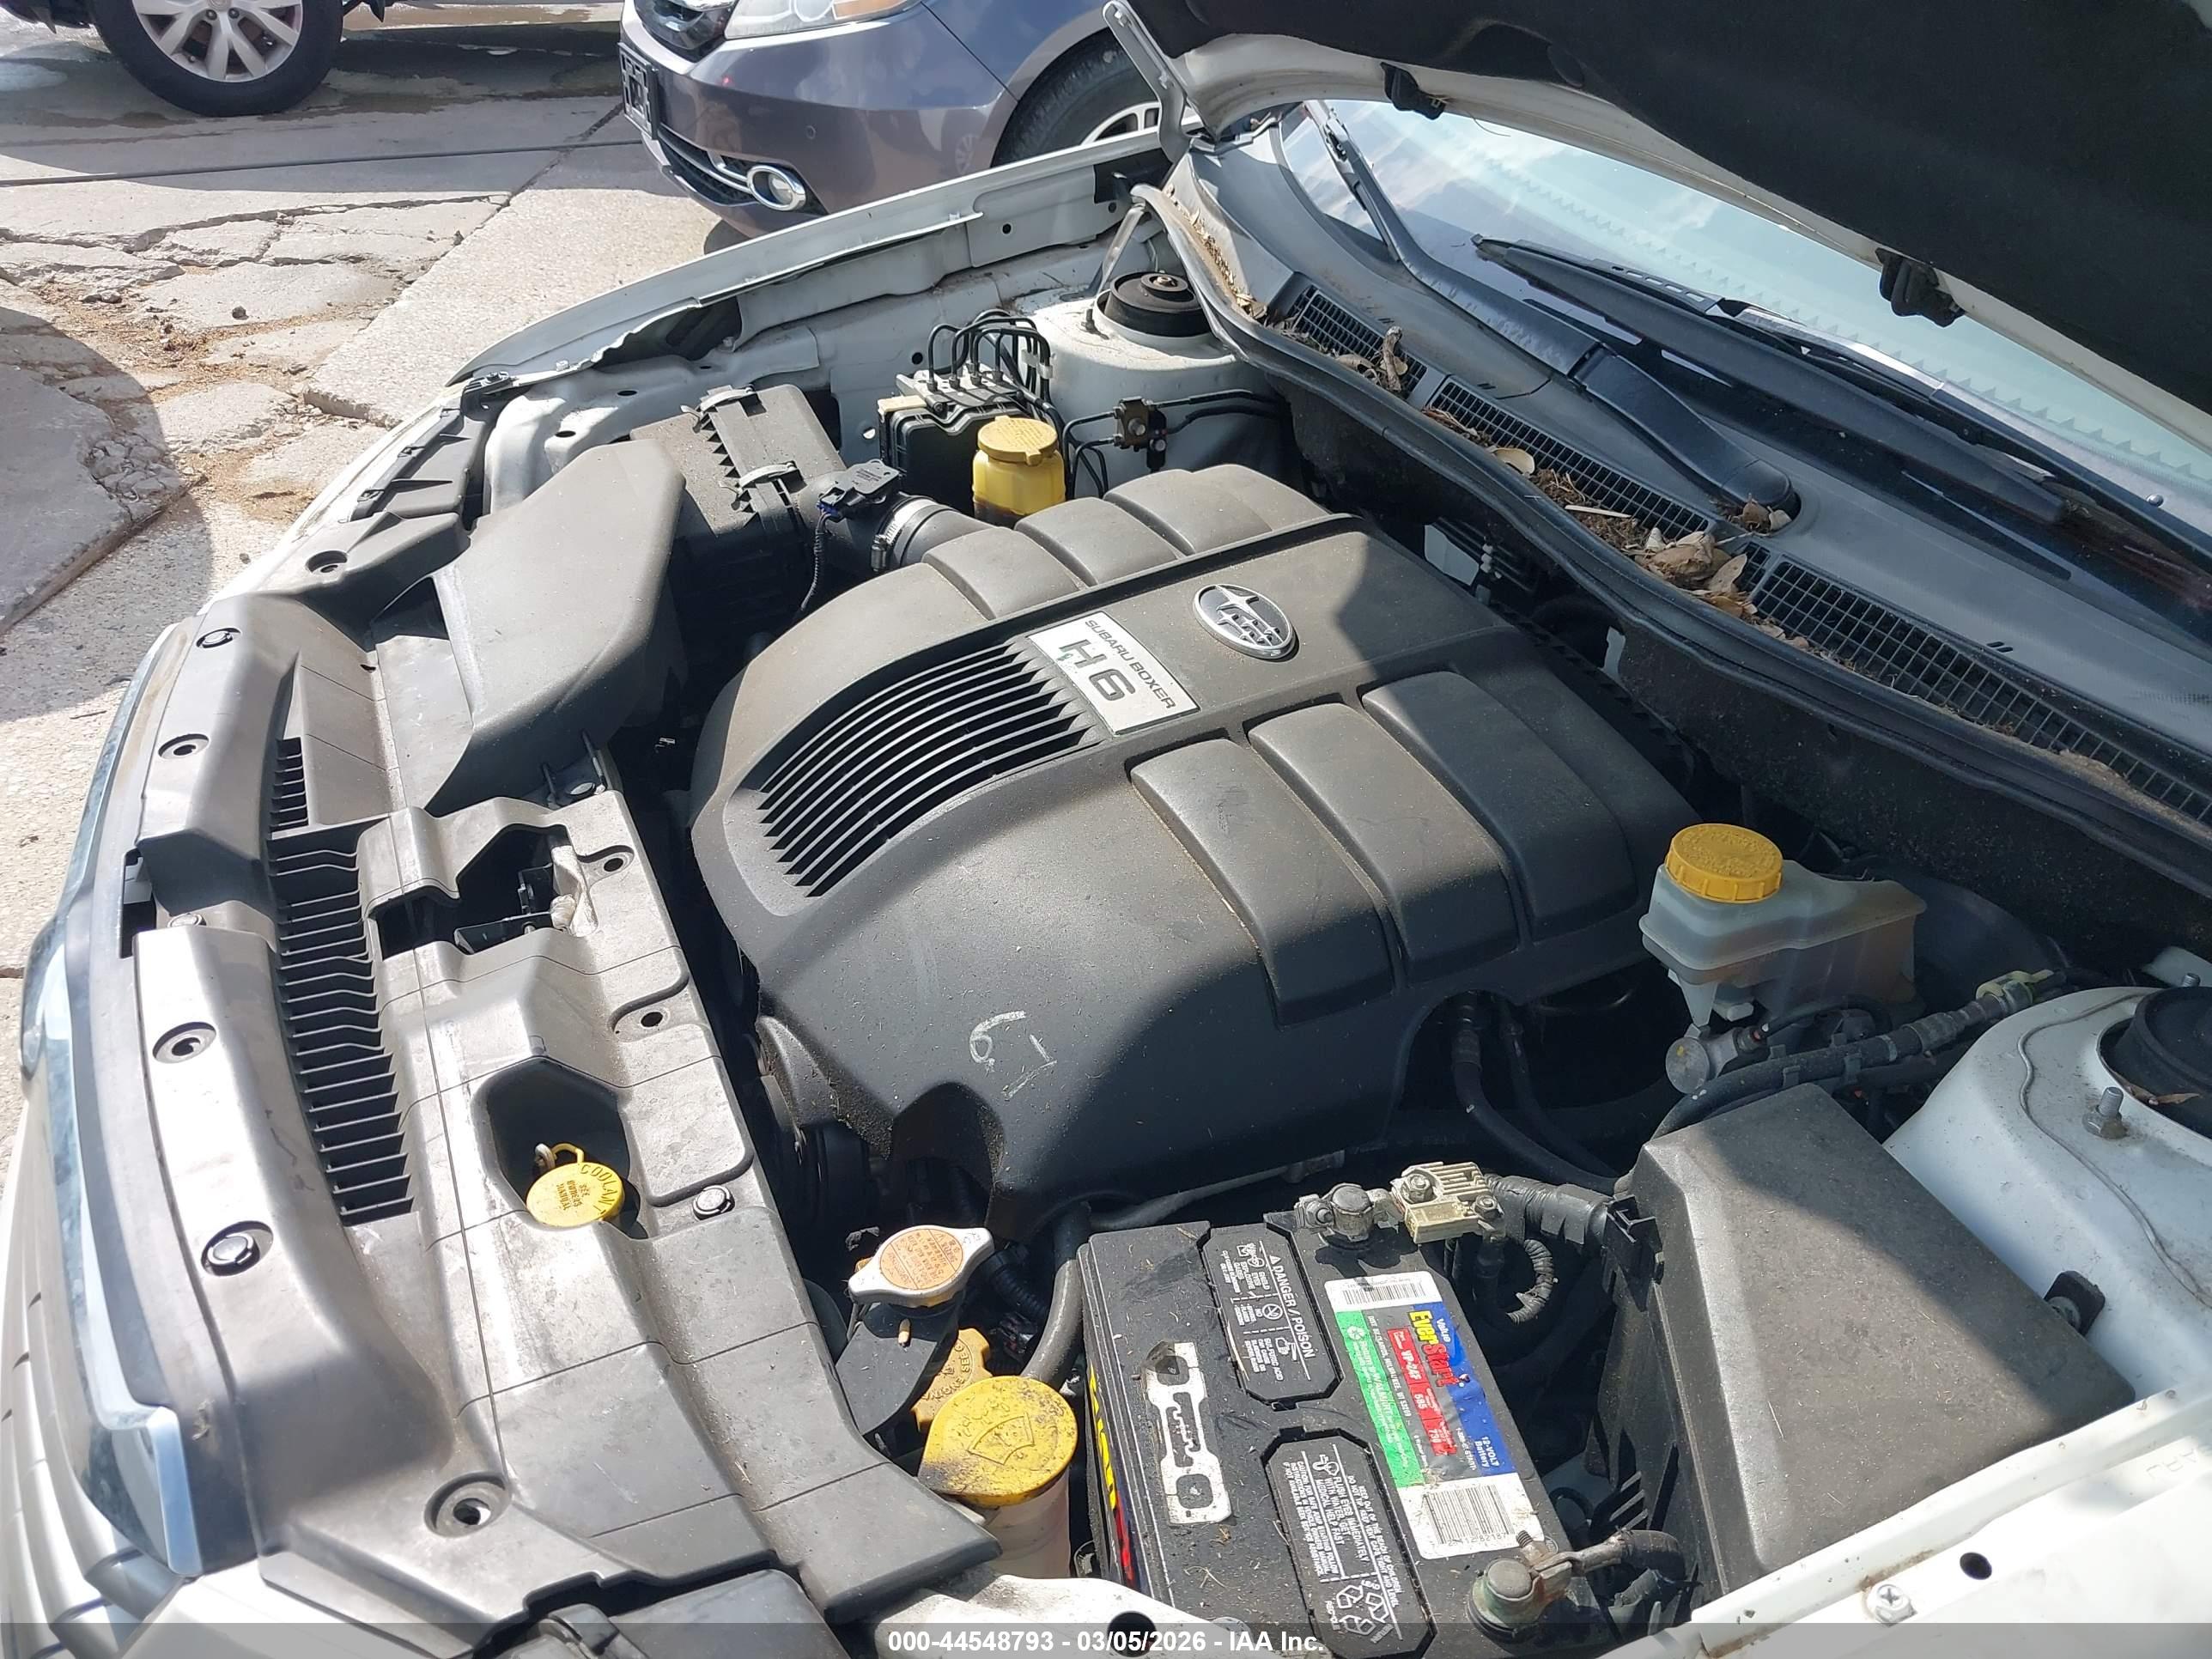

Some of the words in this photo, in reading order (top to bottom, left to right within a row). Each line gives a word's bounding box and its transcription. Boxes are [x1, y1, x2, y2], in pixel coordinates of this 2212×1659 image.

[1084, 619, 1134, 663] SUBARU
[1130, 659, 1176, 709] BOXER
[580, 1164, 617, 1215] COOLANT
[1254, 1308, 1262, 1317] NO
[1273, 1265, 1297, 1307] DANGER
[1290, 1316, 1315, 1358] POISON
[1434, 1318, 1453, 1342] Value
[959, 1352, 969, 1371] SEE
[1262, 1337, 1279, 1365] SULFURIC
[1273, 1366, 1284, 1380] ACID
[1407, 1310, 1462, 1387] EverStart
[1473, 1440, 1492, 1468] Battery
[1480, 1436, 1500, 1467] 12-VOLT
[1315, 1479, 1332, 1507] MEDICAL
[1331, 1476, 1347, 1498] FLUSH
[1357, 1486, 1369, 1499] KEEP
[1363, 1500, 1373, 1512] OUT
[1323, 1477, 1336, 1494] WITH
[1338, 1522, 1350, 1536] GET
[1324, 1509, 1338, 1526] HELP
[1339, 1498, 1353, 1516] EYES
[1349, 1485, 1360, 1497] NOT
[1358, 1509, 1370, 1522] KEEP
[1369, 1540, 1381, 1555] CAPS
[1330, 1527, 1344, 1545] FAST
[1345, 1517, 1370, 1561] IMMEDIATELY
